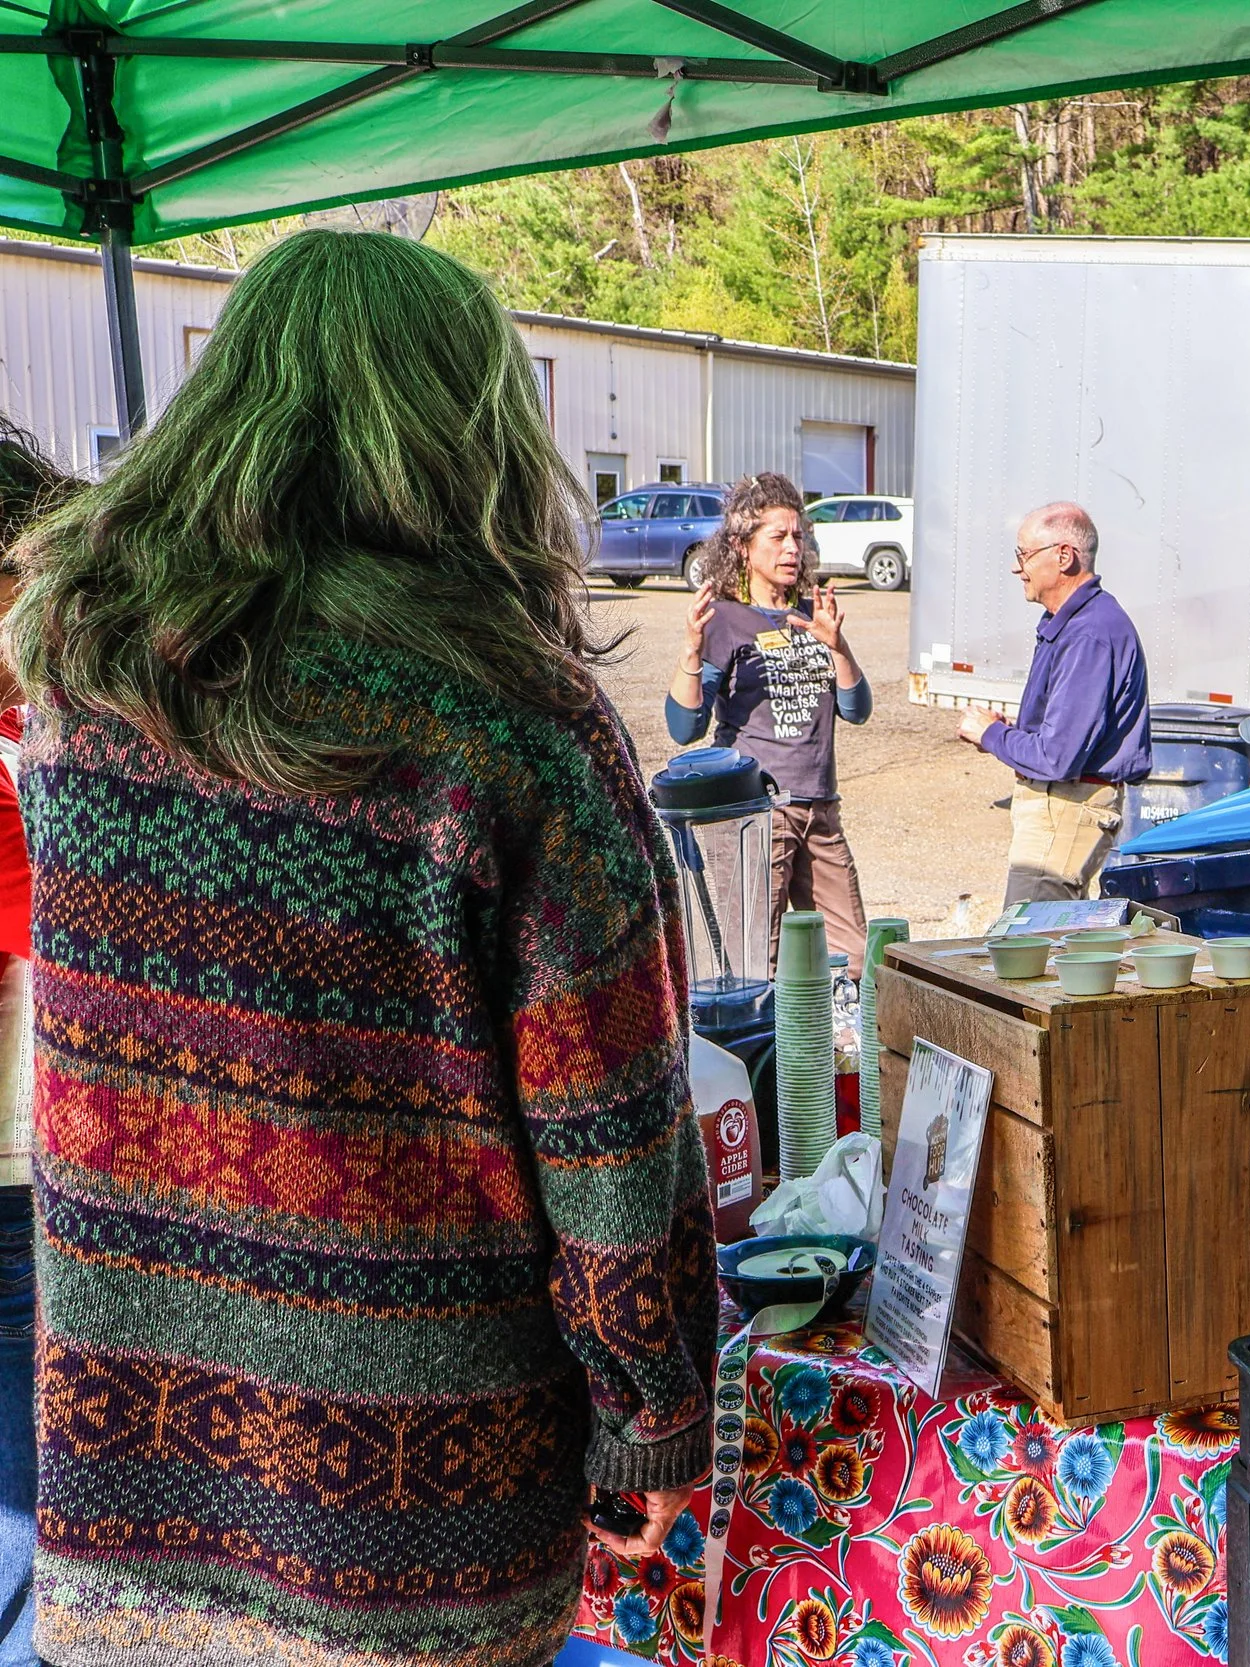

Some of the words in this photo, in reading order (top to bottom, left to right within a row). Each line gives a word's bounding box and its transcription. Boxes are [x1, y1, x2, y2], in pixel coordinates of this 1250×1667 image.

[773, 709, 812, 725] You&
[774, 724, 802, 739] Me.
[720, 1149, 748, 1167] APPLE
[721, 1160, 748, 1176] CIDER
[901, 1187, 949, 1235] CHOCOLATE
[911, 1218, 930, 1246] MILK
[901, 1233, 934, 1273] TASTING
